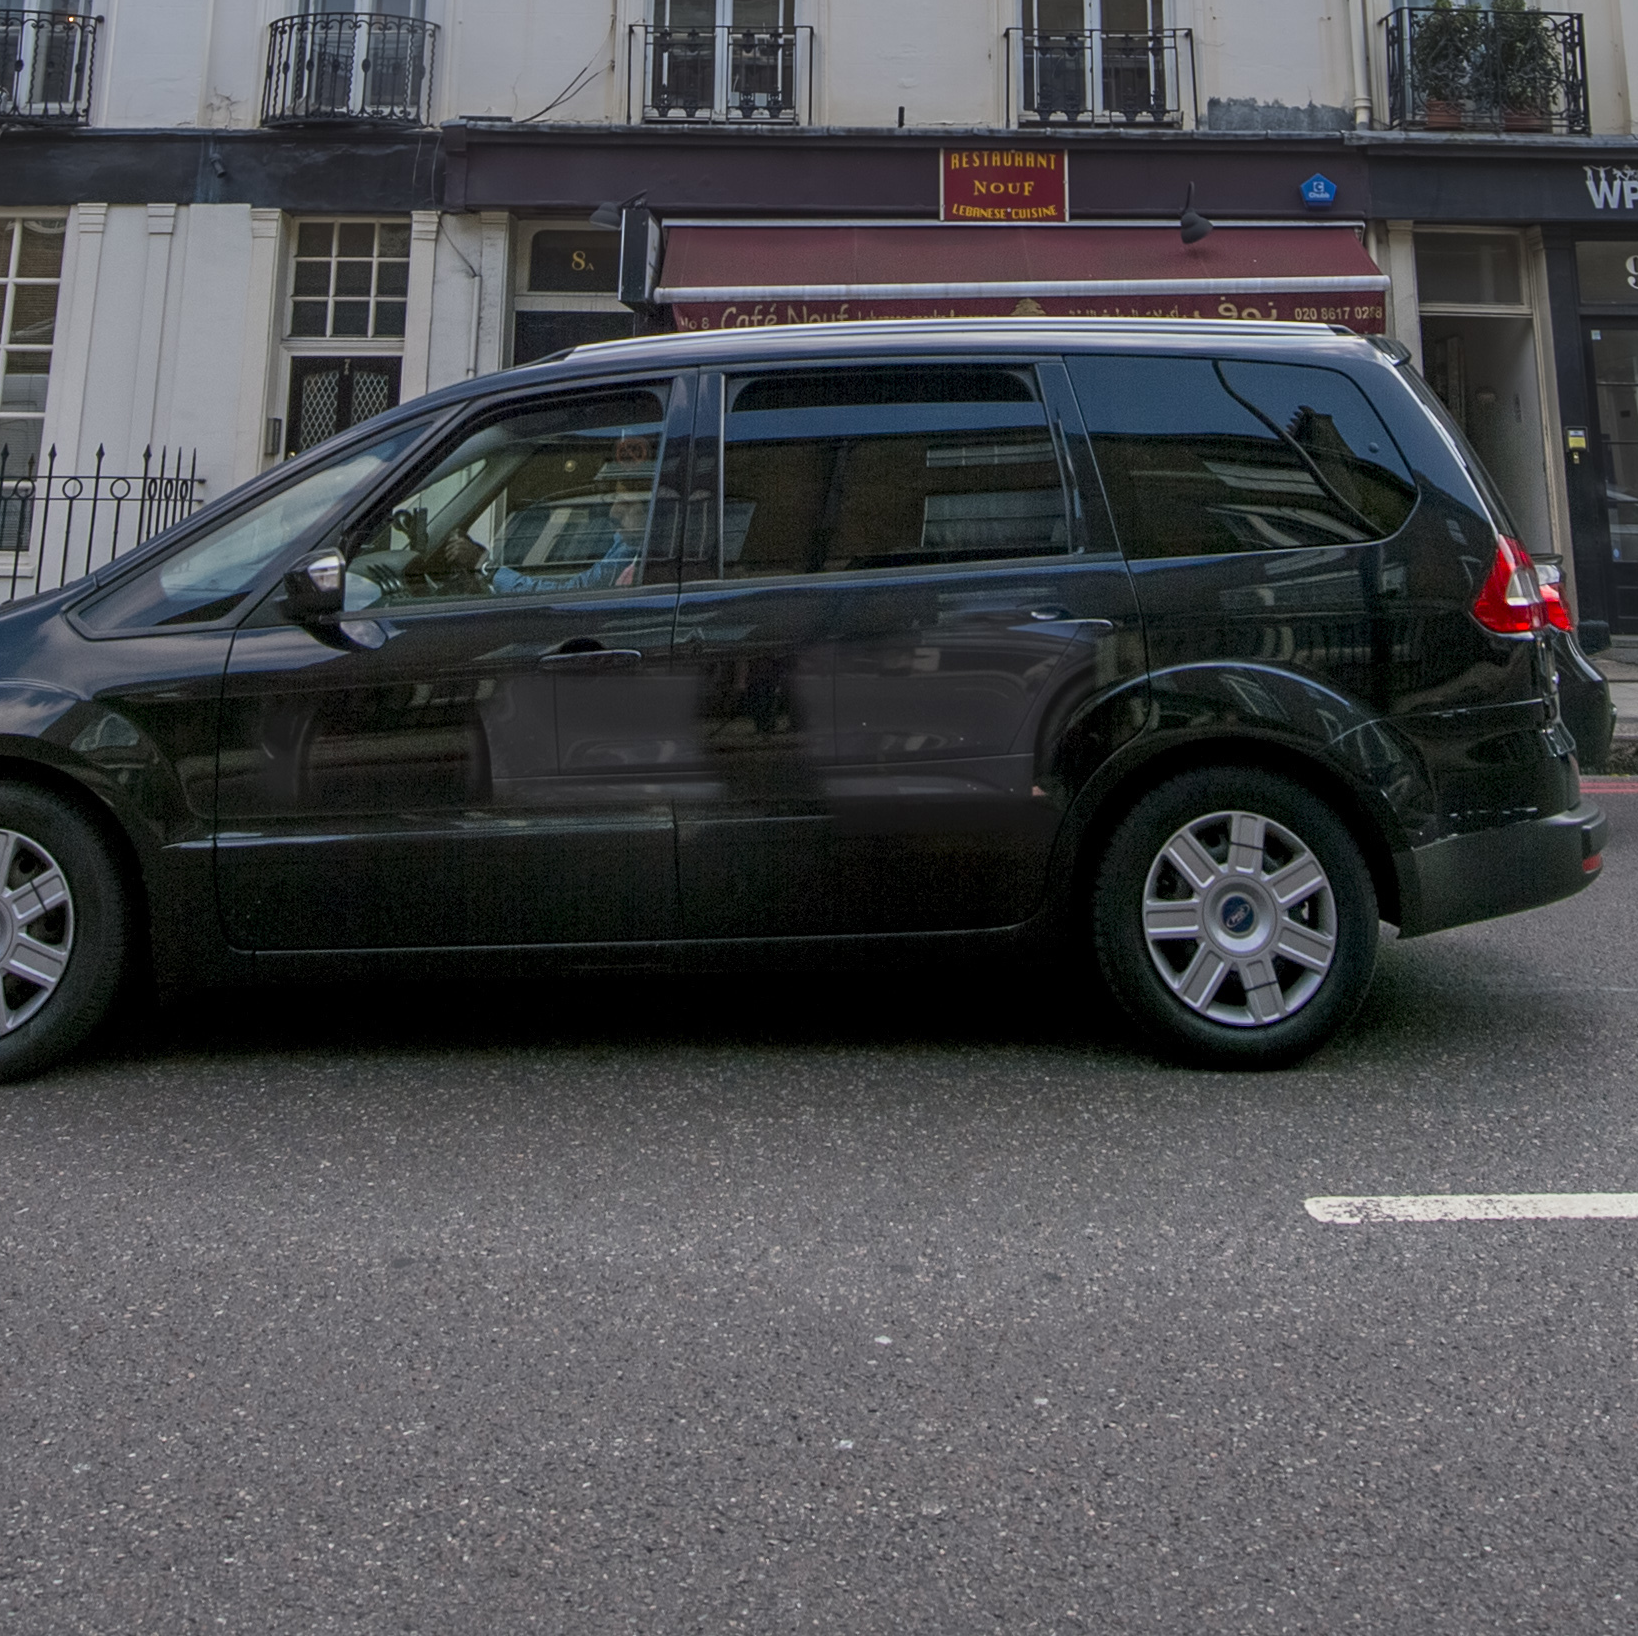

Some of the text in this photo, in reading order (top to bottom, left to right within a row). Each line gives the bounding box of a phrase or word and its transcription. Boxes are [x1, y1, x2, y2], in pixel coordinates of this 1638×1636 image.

[951, 151, 1056, 171] RESTAURANT
[973, 180, 1035, 196] NOUF
[952, 203, 1058, 219] LEBANESE CUISINE
[1295, 308, 1318, 321] 020
[1321, 307, 1350, 320] 8617
